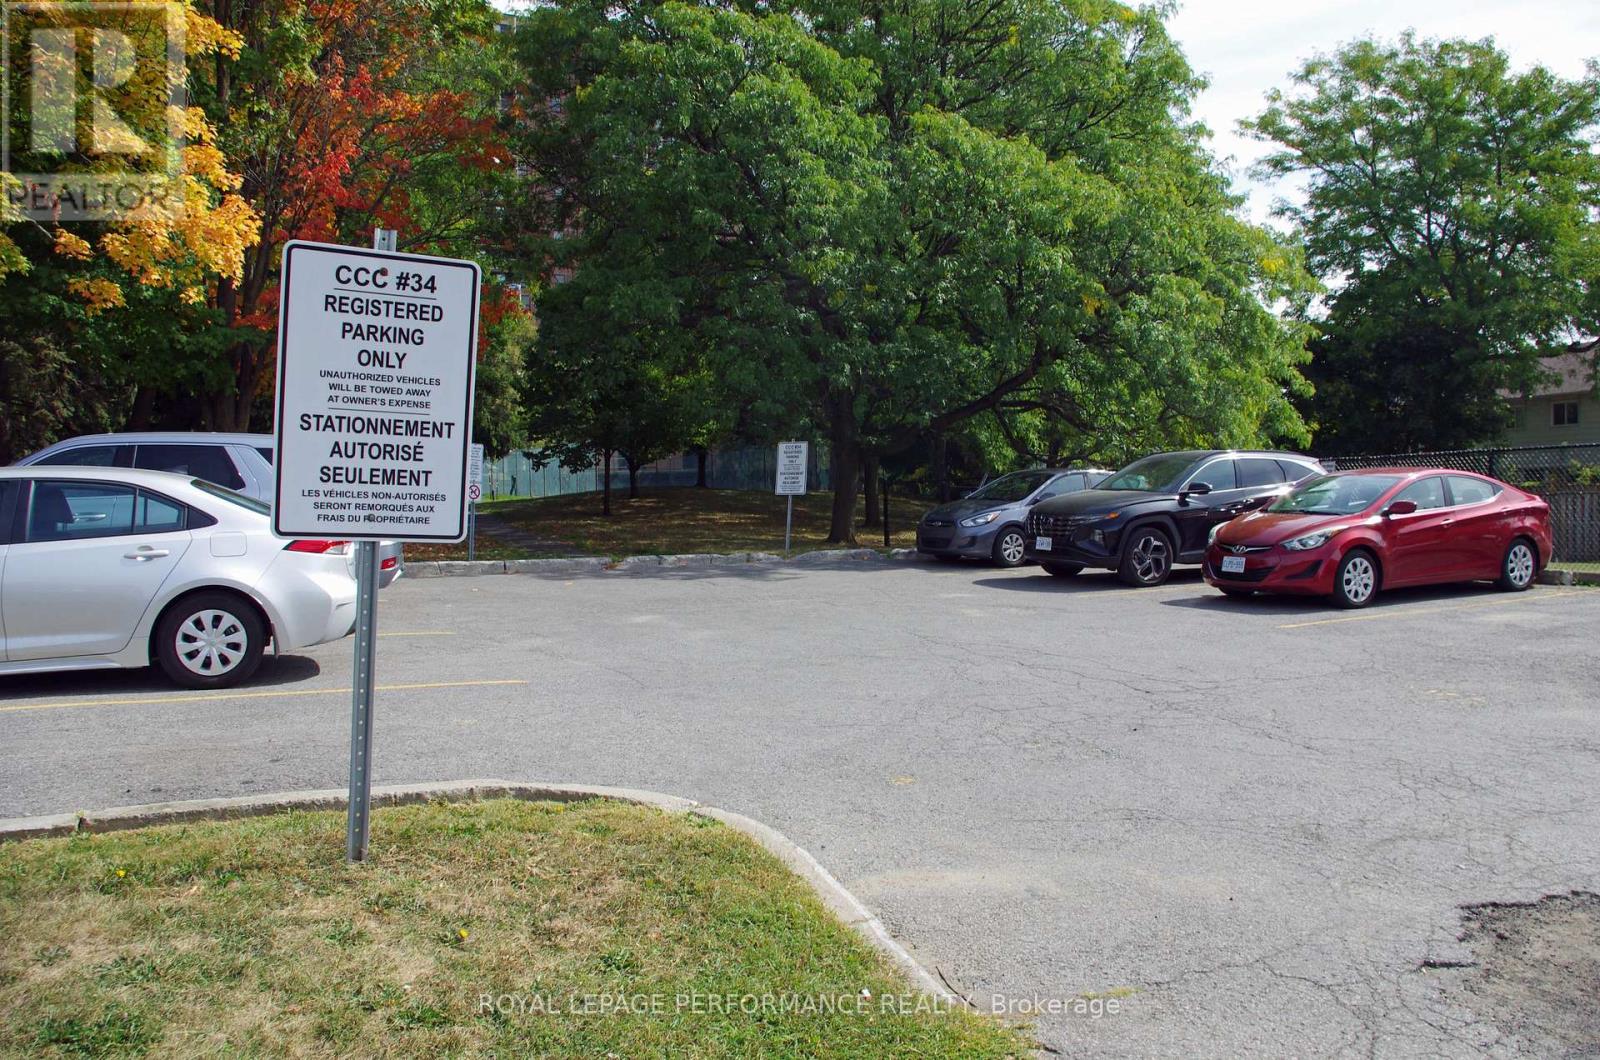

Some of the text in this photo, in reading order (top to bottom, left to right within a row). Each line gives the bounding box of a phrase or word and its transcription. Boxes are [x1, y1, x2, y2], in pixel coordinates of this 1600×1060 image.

[335, 265, 437, 293] CCC #34
[324, 294, 443, 322] REGISTERED
[341, 322, 424, 345] PARKING
[357, 349, 407, 369] ONLY
[319, 370, 441, 386] UNAUTHORIZED VEHICLES
[328, 382, 431, 397] WILL BE TOWED AWAY
[327, 395, 431, 409] AT OWNER'S EXPENSE
[300, 413, 455, 439] STATIONNEMENT
[329, 441, 424, 462] AUTORISÉ
[319, 466, 433, 487] SEULEMENT
[301, 488, 447, 501] LES VÉHICLES NON-AUTORISÉS
[313, 502, 435, 513] SERONT REMORQUÉS AUX
[317, 513, 430, 524] FRAIS DU POPRIÉTAIRE
